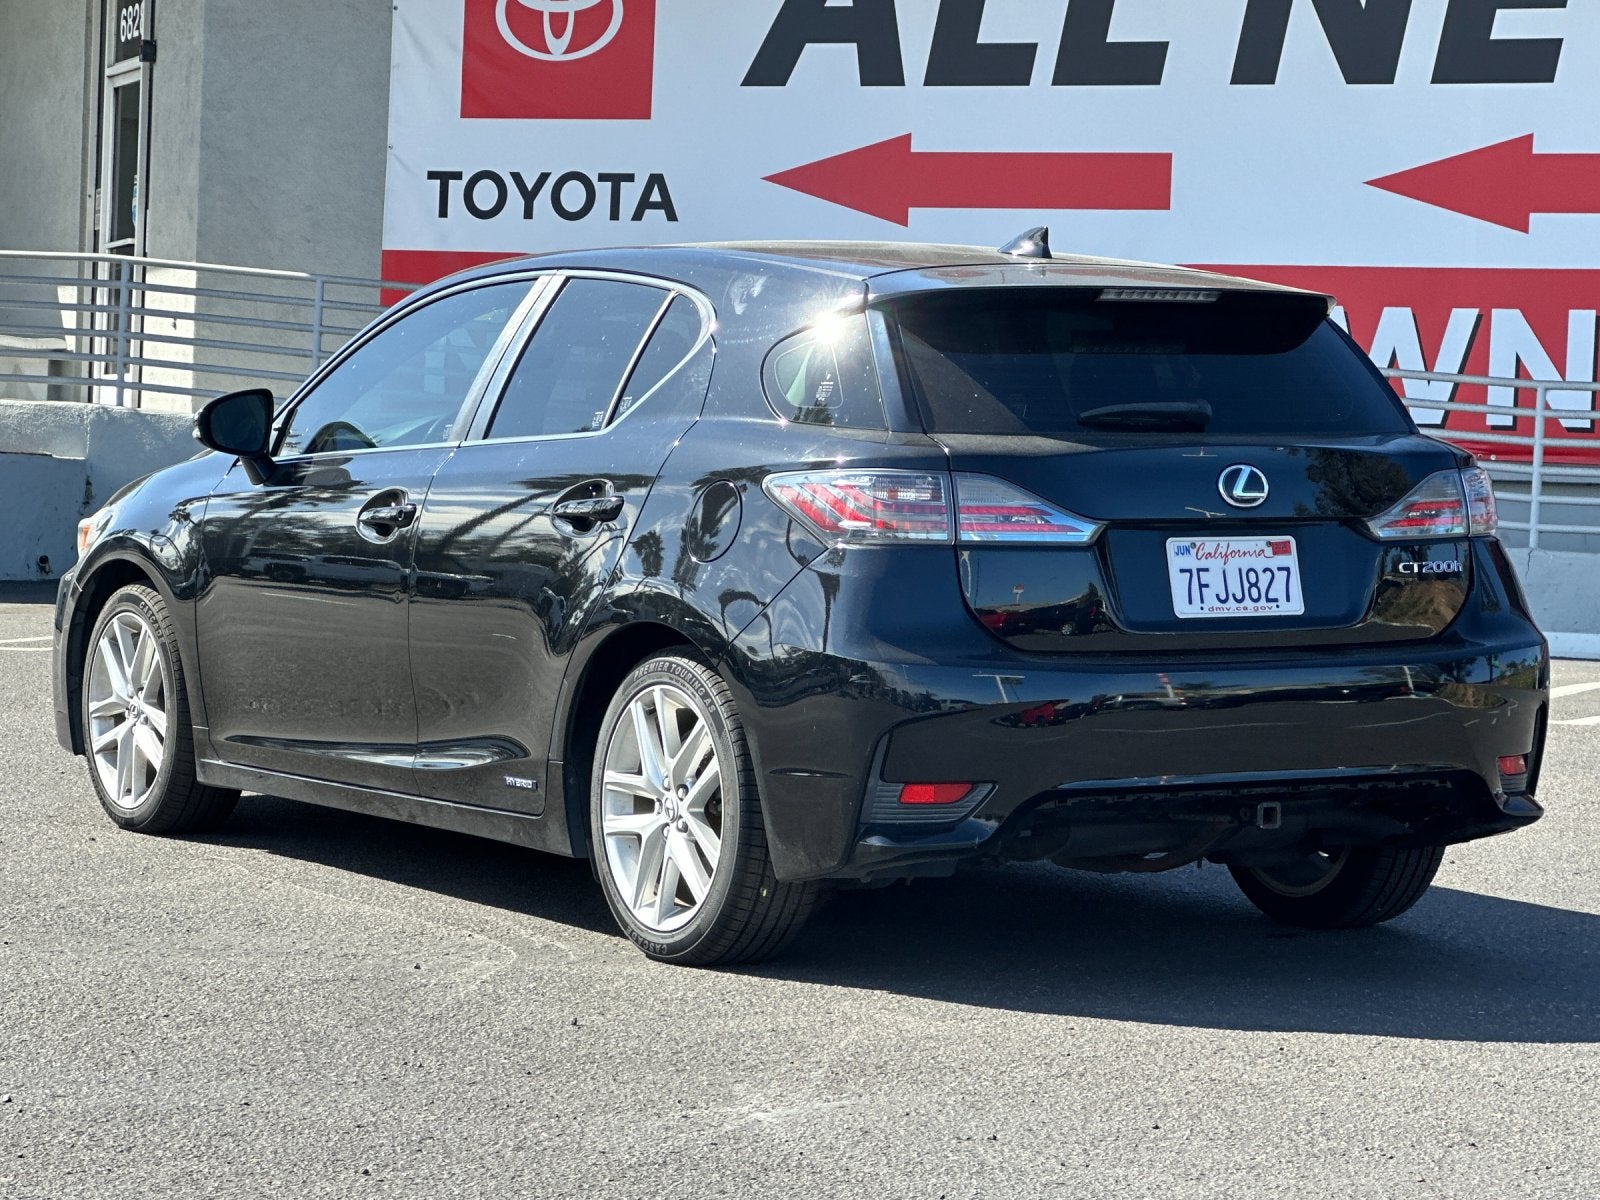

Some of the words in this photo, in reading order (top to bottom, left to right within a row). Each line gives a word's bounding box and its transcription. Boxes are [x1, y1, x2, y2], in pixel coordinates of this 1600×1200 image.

[427, 169, 679, 222] TOYOTA
[1174, 545, 1191, 556] JUN
[1195, 541, 1274, 566] California
[1178, 566, 1292, 606] 7FJJ827
[1207, 604, 1274, 613] dmv.ca.gov
[633, 661, 669, 681] PREMIER
[669, 664, 706, 696] TOURING
[703, 698, 716, 713] AS
